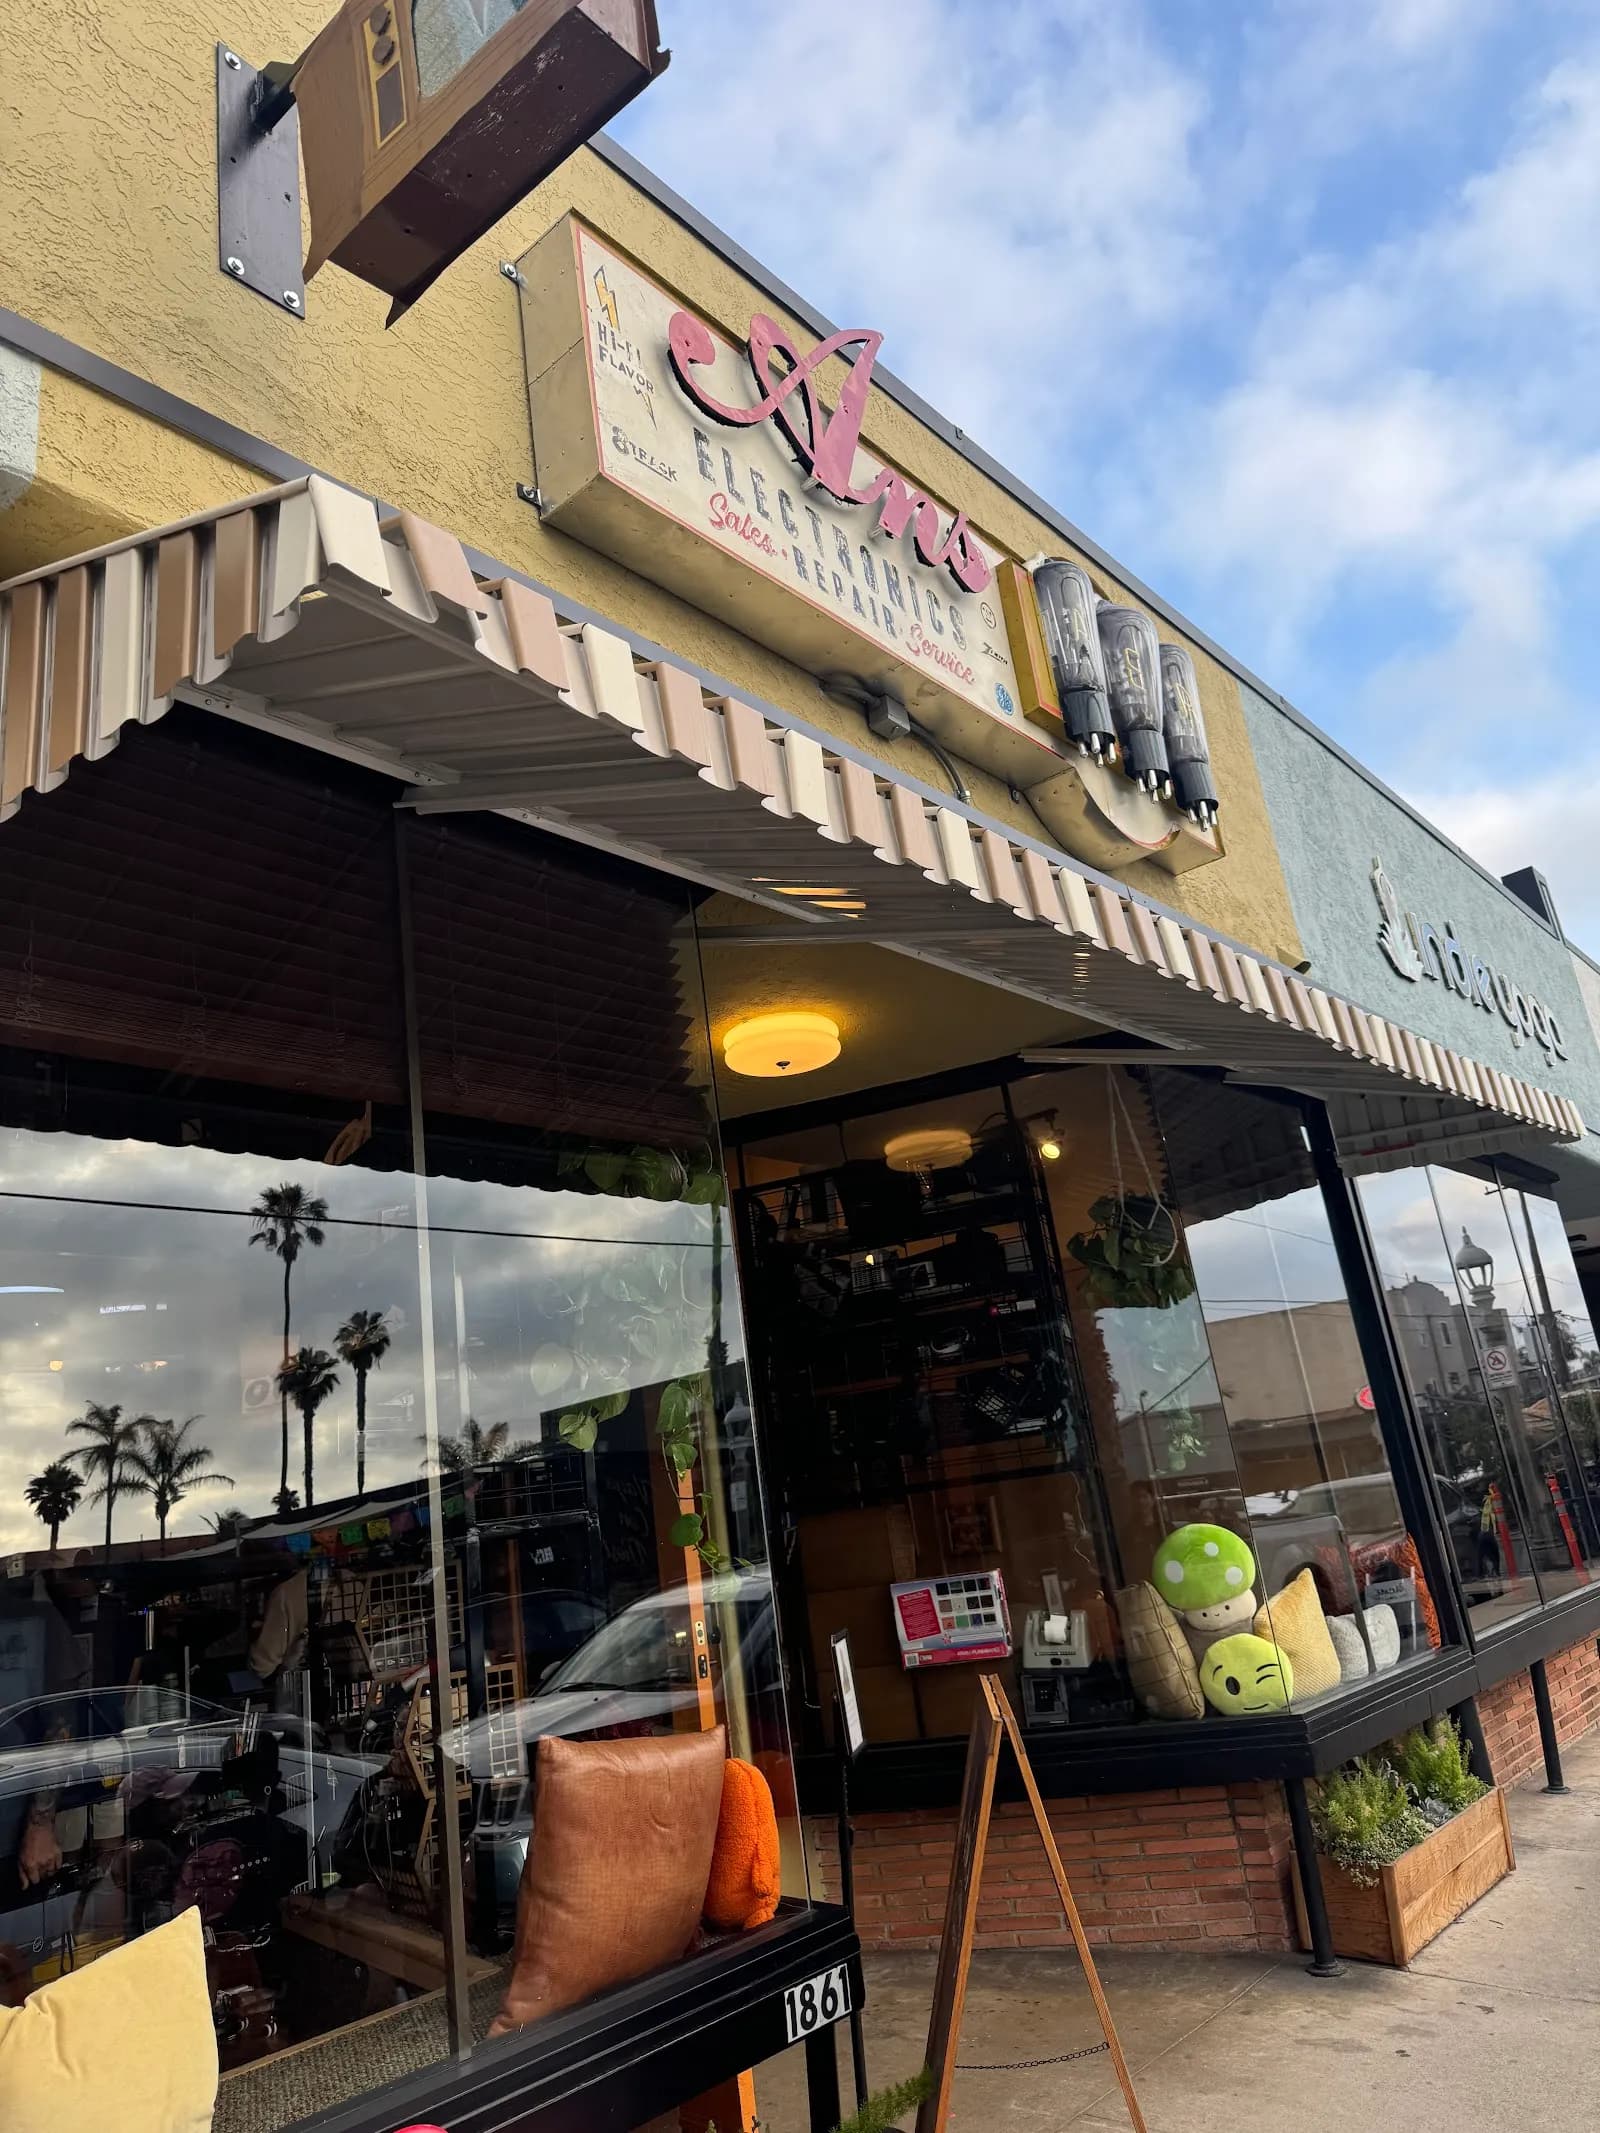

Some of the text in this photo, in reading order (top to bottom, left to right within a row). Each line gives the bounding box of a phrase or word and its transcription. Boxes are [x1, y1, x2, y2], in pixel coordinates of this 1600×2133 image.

[598, 343, 655, 394] FLAVOR
[693, 426, 967, 651] ELECTRONICS
[709, 492, 976, 685] Sales REPAIR Service
[786, 1965, 850, 2039] 1861
